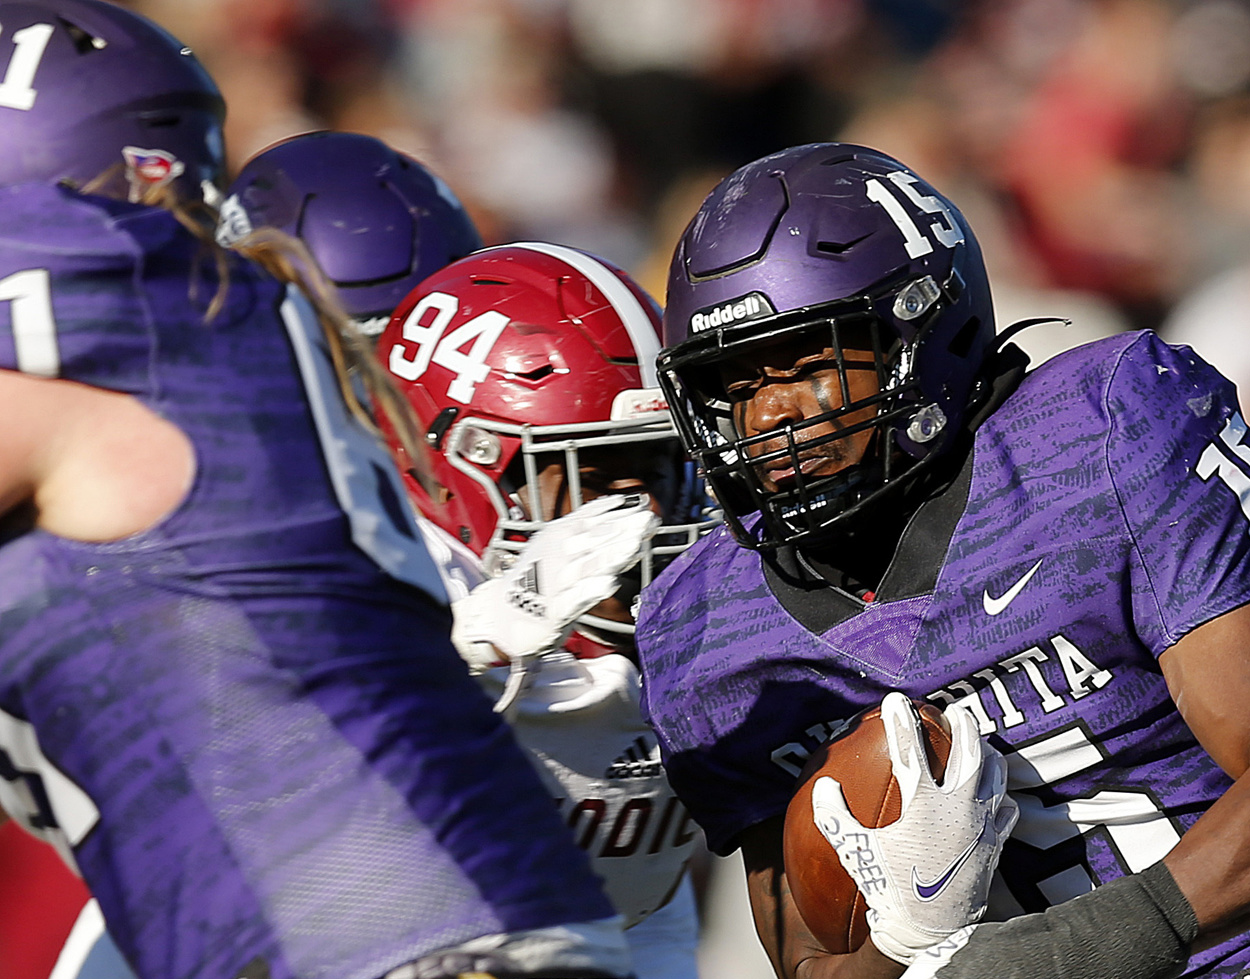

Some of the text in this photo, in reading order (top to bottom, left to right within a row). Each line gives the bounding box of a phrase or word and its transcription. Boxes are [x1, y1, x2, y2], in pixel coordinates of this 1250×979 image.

[864, 170, 965, 260] 15
[389, 291, 511, 404] 94
[691, 296, 761, 334] Riddell
[844, 831, 887, 897] FREE
